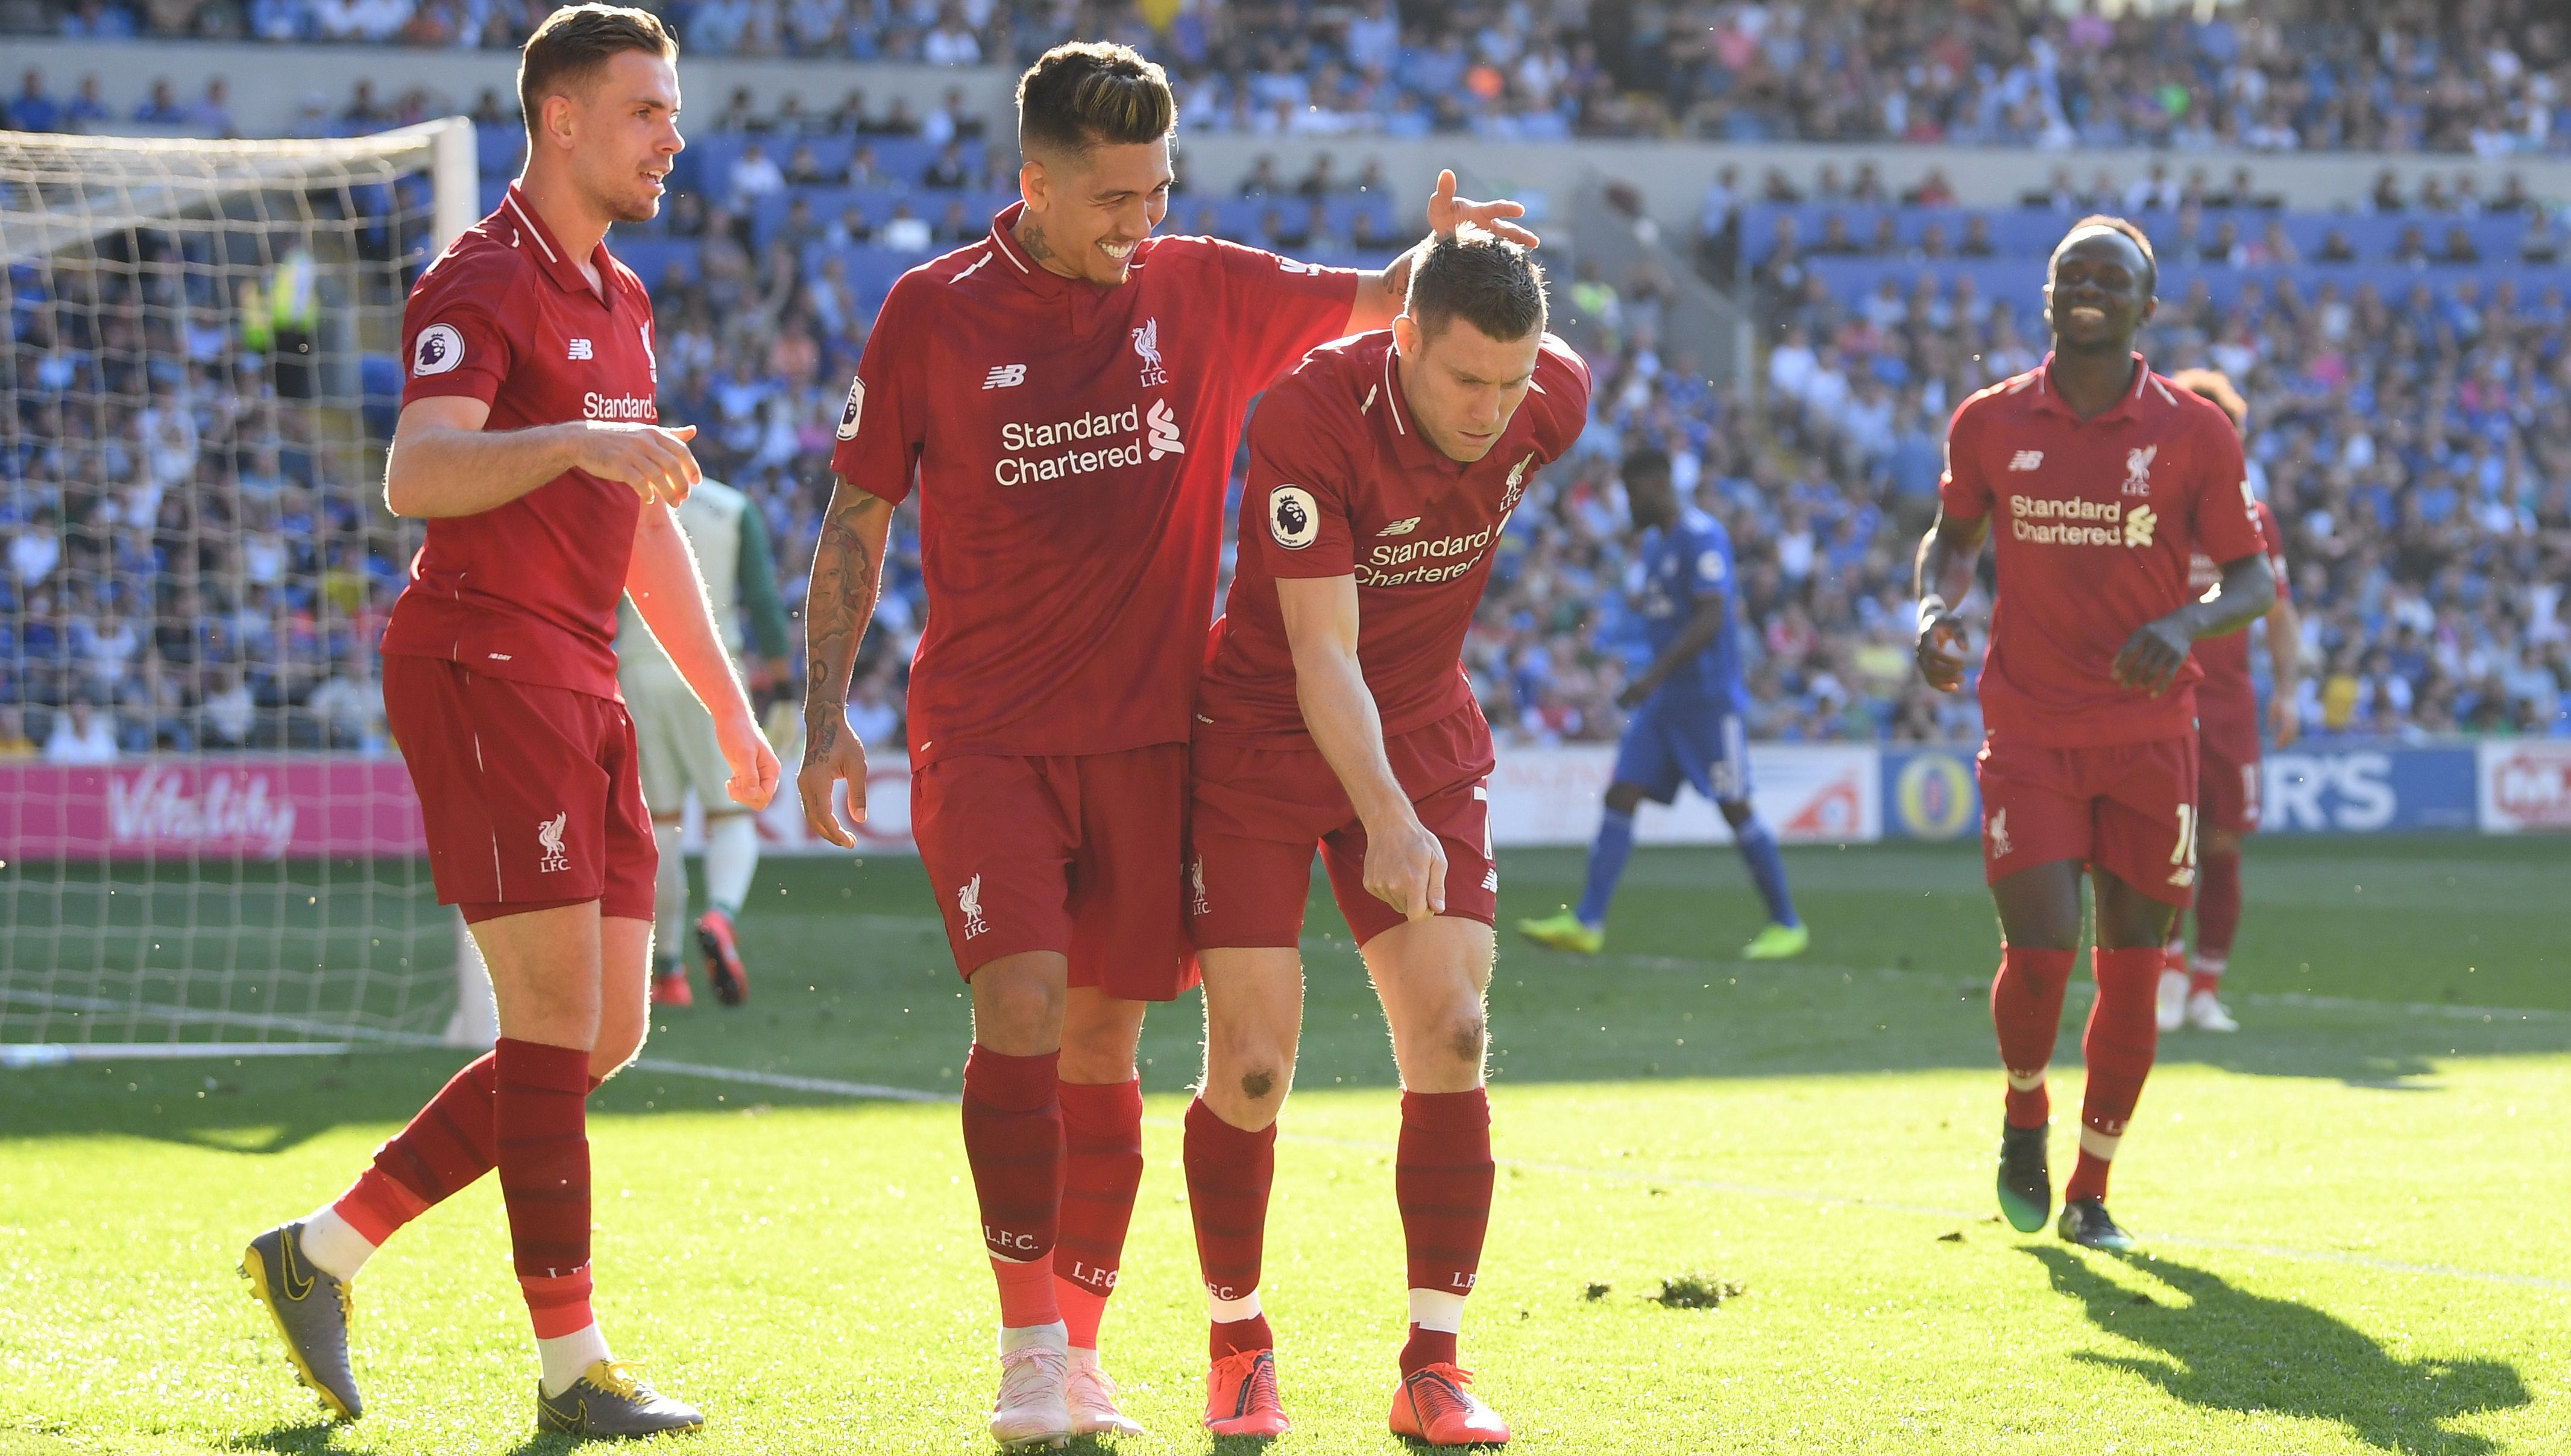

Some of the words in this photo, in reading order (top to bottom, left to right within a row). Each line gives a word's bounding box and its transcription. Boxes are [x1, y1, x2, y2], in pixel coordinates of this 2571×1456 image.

[981, 364, 1027, 390] NB
[583, 392, 652, 418] Standard
[1002, 404, 1139, 451] Standard
[995, 438, 1142, 486] Chartered
[2010, 495, 2121, 523] Standard
[1369, 524, 1491, 565] Standard
[2012, 517, 2121, 546] Chartered
[1354, 549, 1484, 587] Chartered
[110, 762, 297, 862] Vitality
[985, 1225, 1039, 1250] L.F.C.
